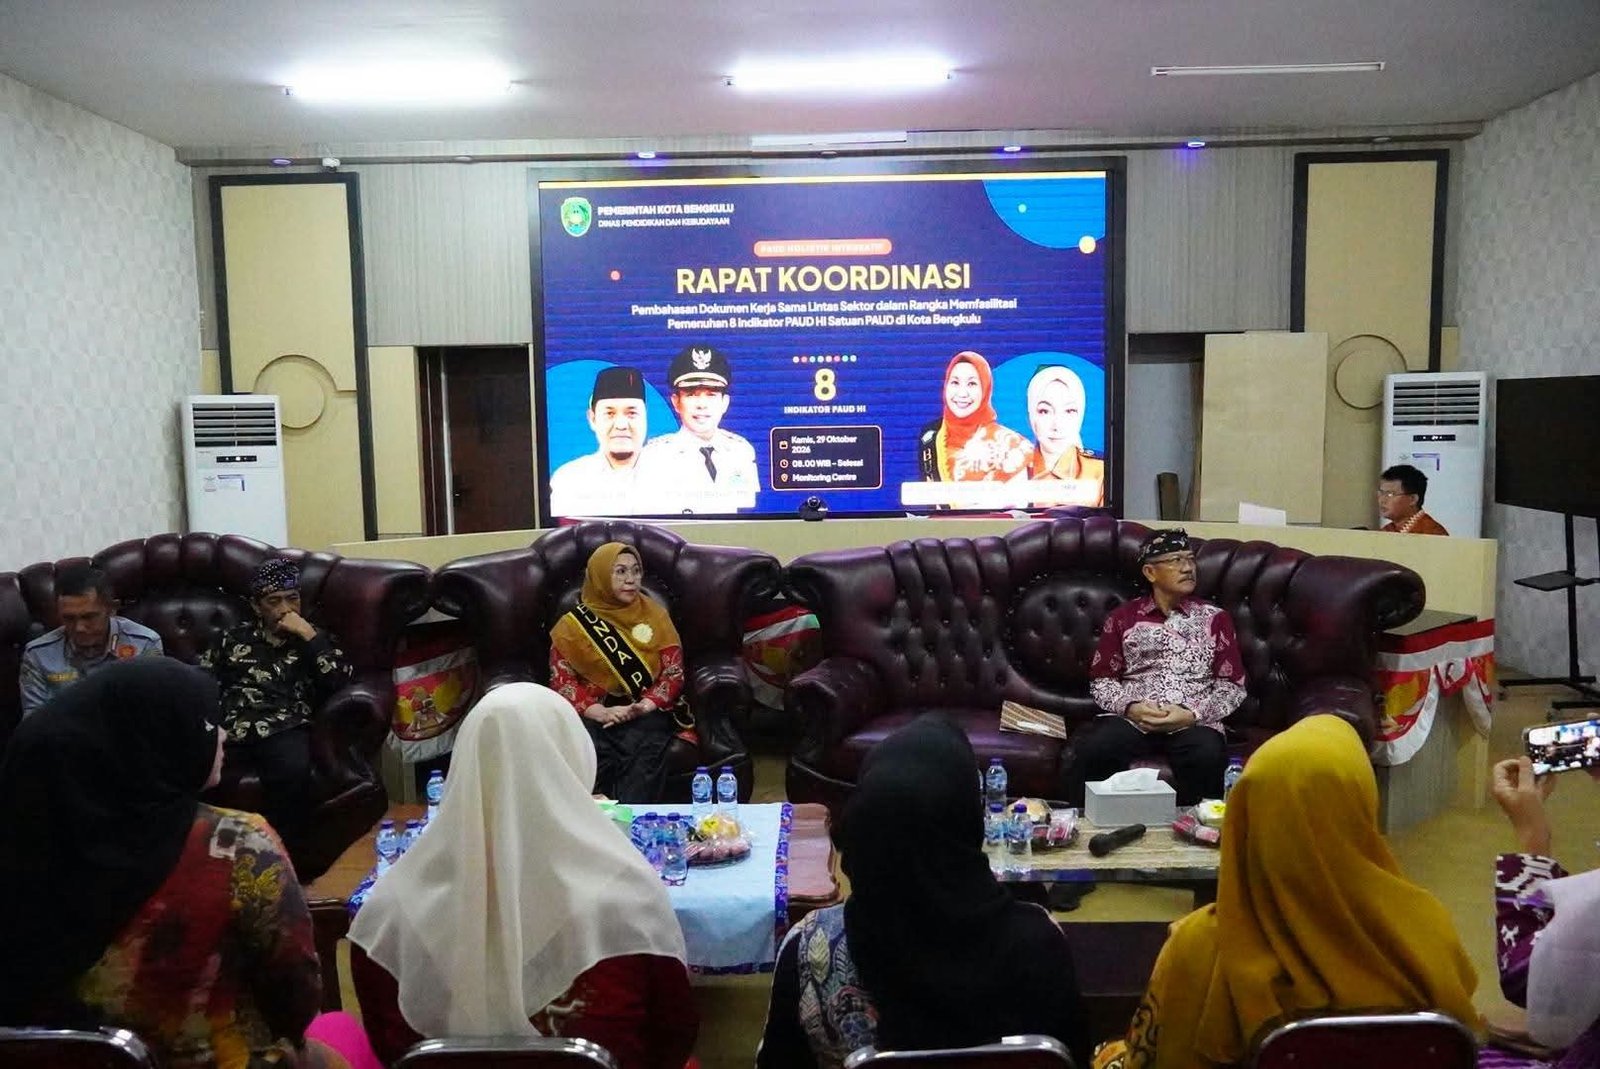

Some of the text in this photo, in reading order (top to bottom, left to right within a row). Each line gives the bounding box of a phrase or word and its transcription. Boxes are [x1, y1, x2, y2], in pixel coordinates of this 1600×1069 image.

[598, 203, 734, 215] PEMERINTAH KOTA BENGKULU
[598, 217, 730, 228] DINAS PENDIDIKAN DAN KEBUDAYAAN
[676, 263, 971, 294] RAPAT KOORDINASI
[631, 298, 1018, 316] Pembahasan Dokumen Kerja Sama Lintas Sektor dalam Rangka Memfasilitasi
[667, 313, 982, 329] Pemenuhan 8 Indikator PAUD HI Satuan PAUD di Kota Bengkulu
[814, 368, 837, 401] 8
[784, 404, 867, 414] INDIKATOR PAUD HI
[791, 434, 857, 445] Kamis, 29 Oktober
[792, 460, 816, 468] 08.00
[816, 459, 831, 468] WIB
[837, 459, 864, 467] Selesai
[792, 472, 857, 483] Monitoring Centre
